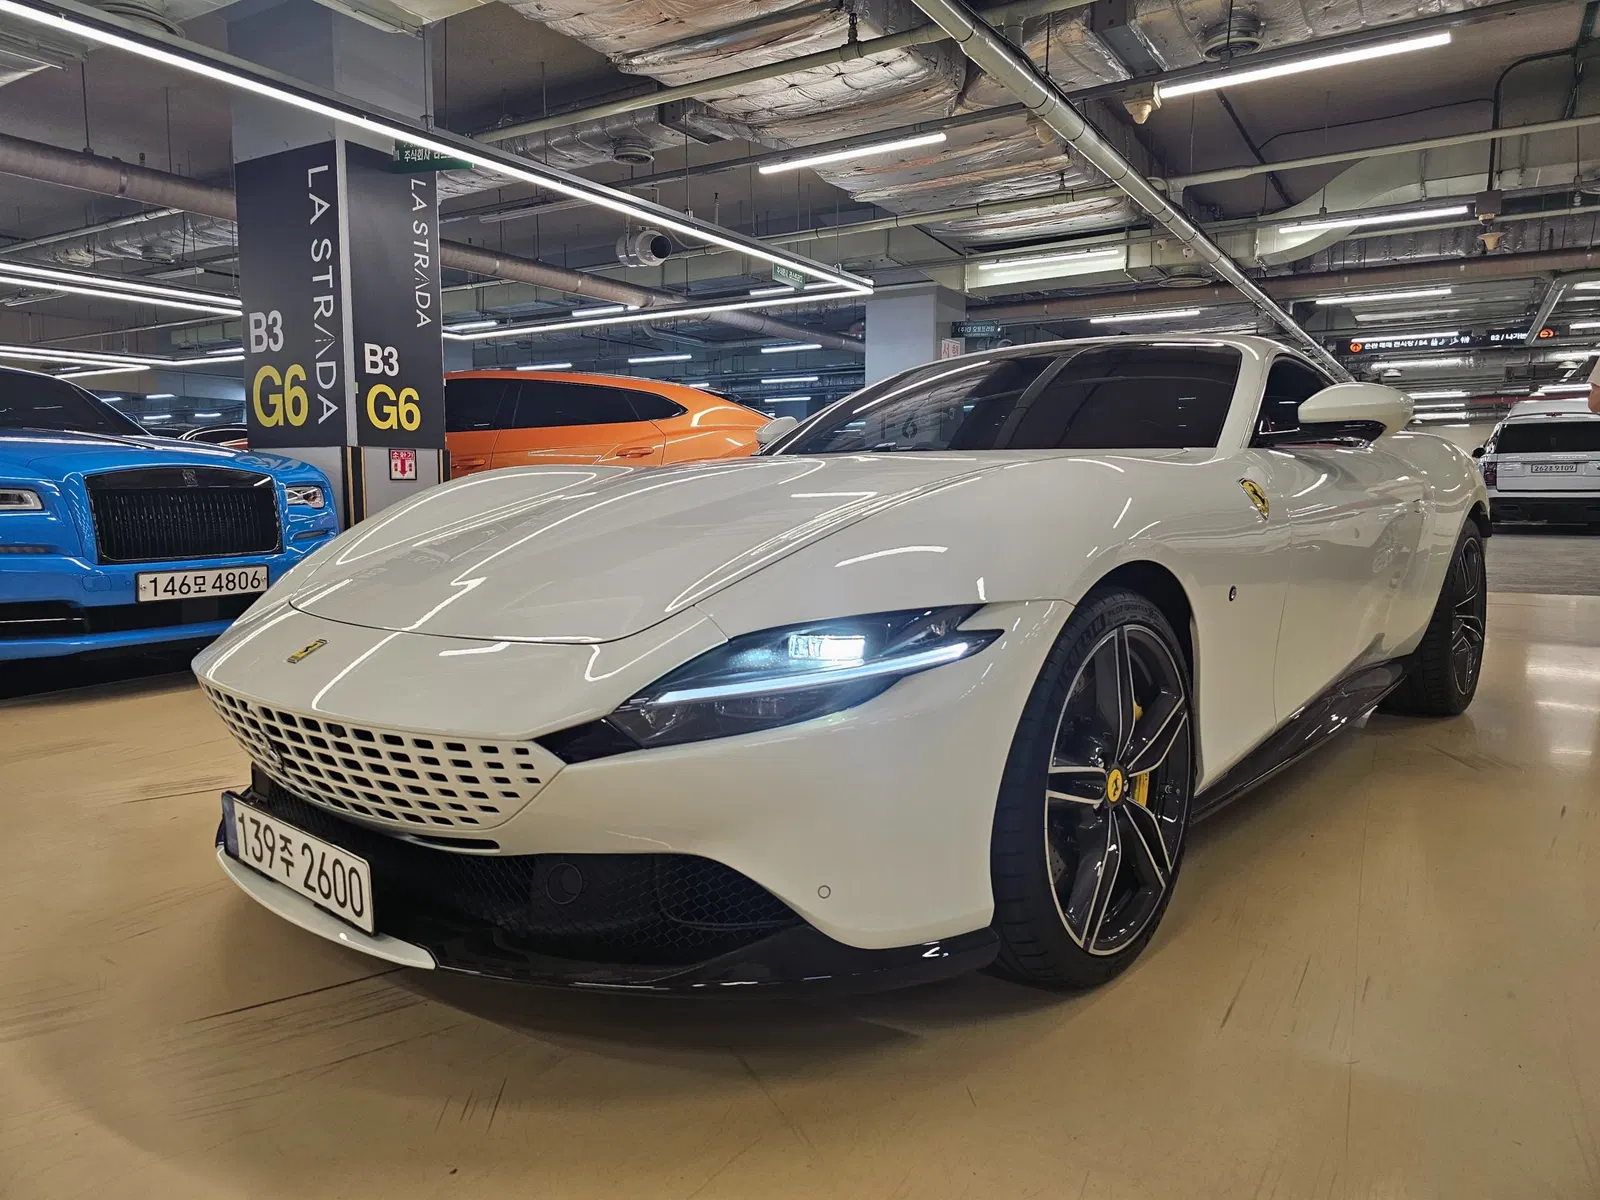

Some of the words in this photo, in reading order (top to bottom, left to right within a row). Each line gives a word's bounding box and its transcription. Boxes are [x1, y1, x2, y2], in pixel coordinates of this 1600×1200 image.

[308, 164, 331, 226] LA
[411, 178, 427, 213] LA
[249, 310, 284, 353] B3
[364, 343, 400, 377] B3
[253, 363, 309, 428] G6
[367, 384, 421, 432] G6
[150, 576, 206, 598] 146모
[212, 570, 262, 592] 4806
[238, 812, 295, 878] 139주
[301, 842, 364, 918] 2600
